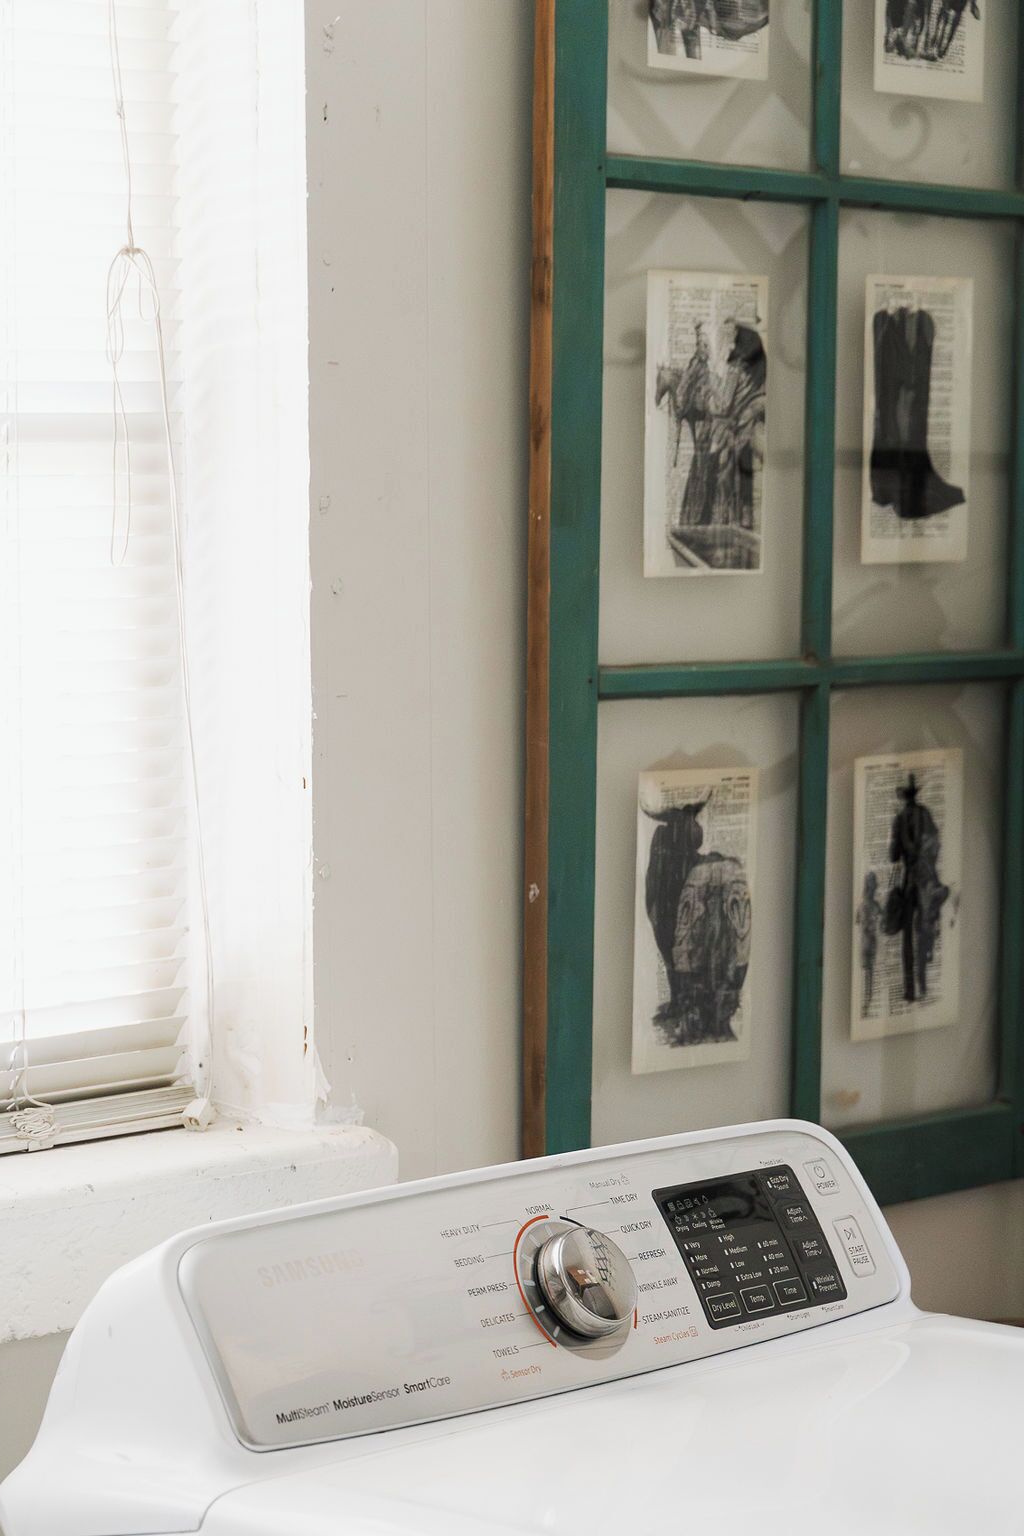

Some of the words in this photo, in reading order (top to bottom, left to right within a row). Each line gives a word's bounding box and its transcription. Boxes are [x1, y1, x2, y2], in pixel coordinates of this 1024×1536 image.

[779, 1175, 789, 1183] Dry
[816, 1180, 836, 1190] POWER
[610, 1195, 626, 1204] TIME
[626, 1193, 638, 1202] DRY
[525, 1204, 554, 1216] NORMAL
[786, 1206, 804, 1216] Adjust
[440, 1228, 462, 1240] HEAVY
[463, 1224, 481, 1234] DUTY
[620, 1223, 641, 1234] QUICK
[640, 1220, 652, 1230] DRY
[723, 1234, 734, 1242] High
[688, 1242, 701, 1250] Very
[729, 1245, 748, 1254] Medium
[802, 1240, 818, 1250] Adjust
[848, 1245, 864, 1254] START
[638, 1249, 666, 1261] REFRESH
[694, 1254, 708, 1262] More
[852, 1256, 870, 1264] PAUSE
[454, 1255, 485, 1268] BEDDING
[735, 1260, 745, 1268] Low
[257, 1249, 367, 1287] SAMSUNG
[700, 1265, 719, 1274] Normal
[772, 1266, 780, 1274] 20
[780, 1264, 790, 1272] min
[740, 1272, 752, 1281] Extra
[752, 1270, 762, 1278] Low
[816, 1274, 835, 1284] Wrinkle
[468, 1285, 486, 1297] PERM
[486, 1282, 508, 1292] PRESS
[637, 1280, 663, 1293] WRINKLE
[662, 1277, 678, 1288] AWAY
[706, 1280, 721, 1289] Damp
[819, 1284, 838, 1292] Prevent
[783, 1286, 798, 1295] Time
[712, 1303, 722, 1312] Dry
[722, 1300, 736, 1310] Level
[480, 1312, 516, 1328] DELICATES
[642, 1312, 664, 1324] STEAM
[664, 1306, 691, 1320] SANITIZE
[653, 1333, 672, 1344] Steam
[672, 1330, 690, 1342] Cycles
[492, 1345, 520, 1359] TOWELS
[510, 1366, 530, 1378] Sensor
[530, 1364, 542, 1375] Dry
[333, 1387, 401, 1412] MoistureSensor
[403, 1375, 451, 1394] SmartCare
